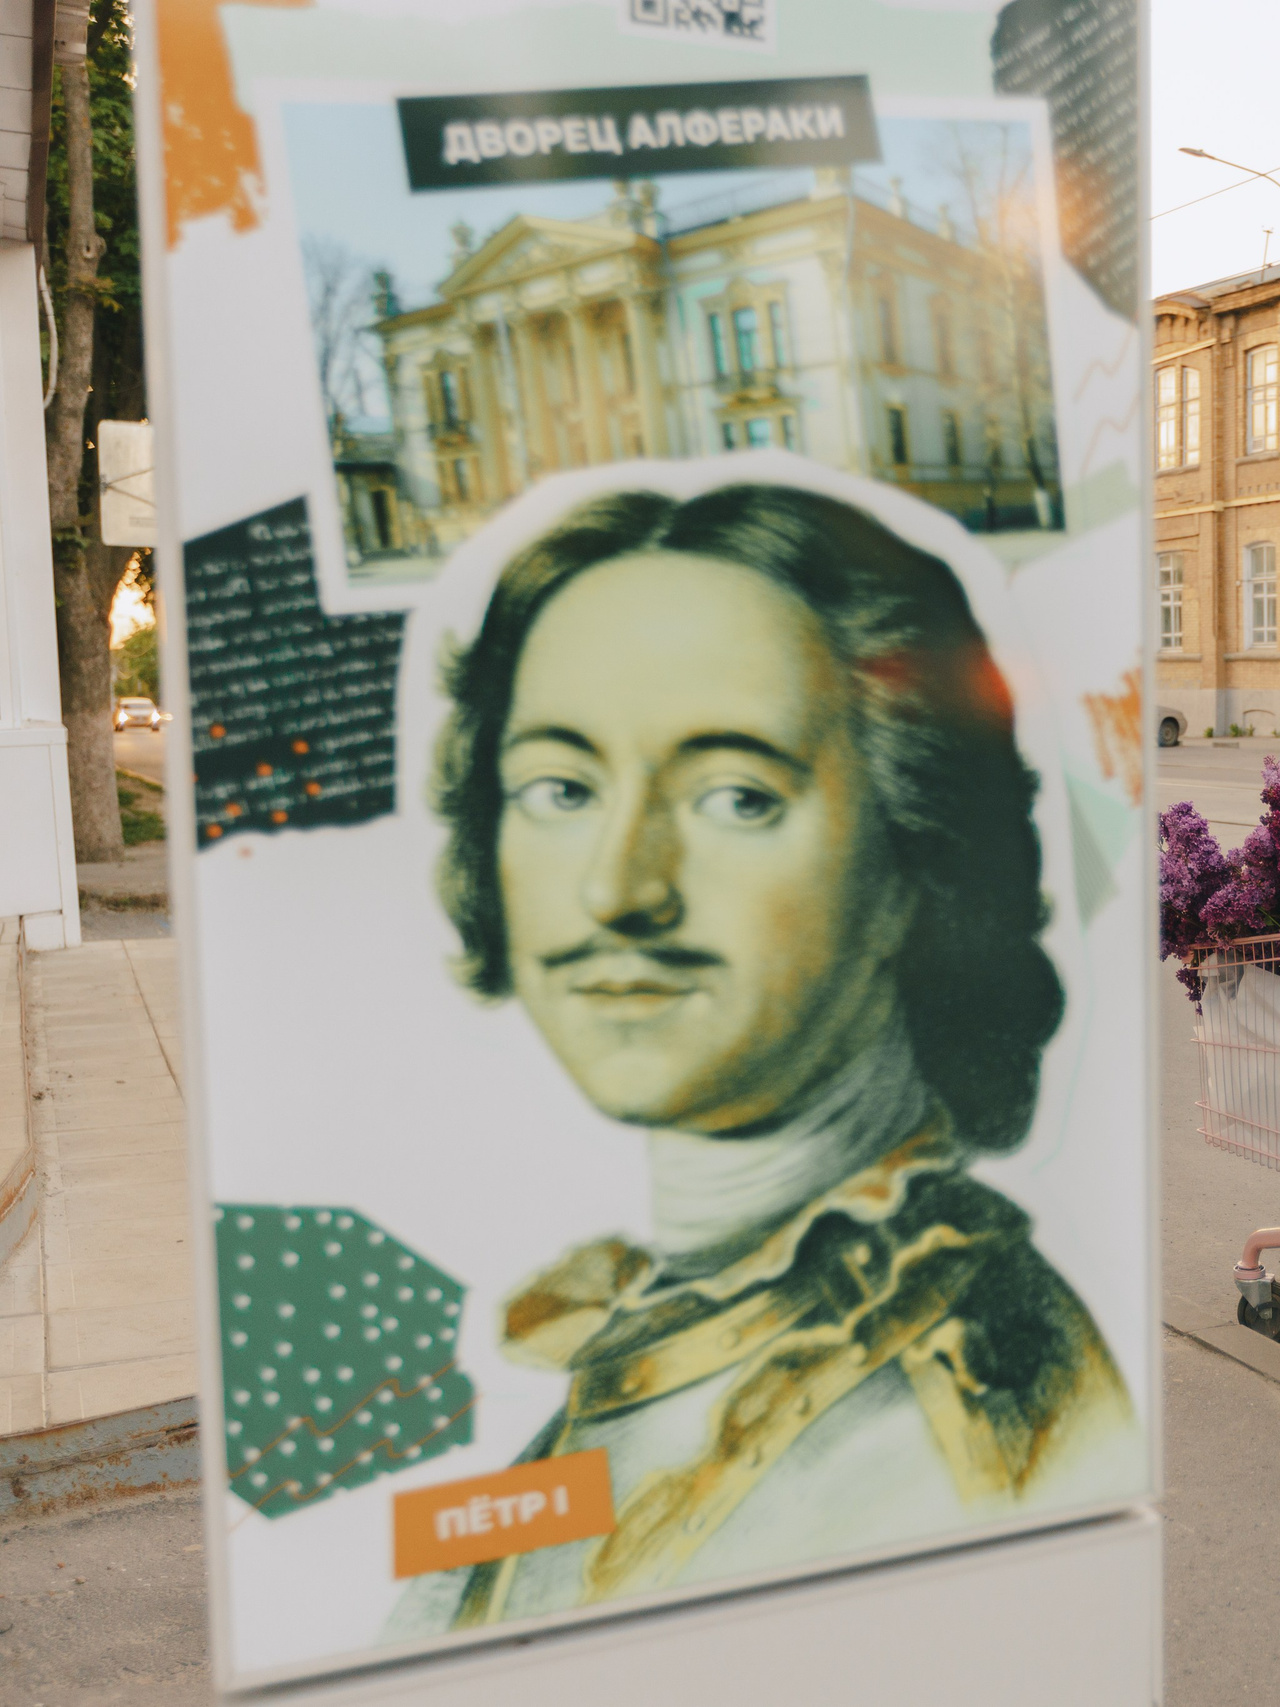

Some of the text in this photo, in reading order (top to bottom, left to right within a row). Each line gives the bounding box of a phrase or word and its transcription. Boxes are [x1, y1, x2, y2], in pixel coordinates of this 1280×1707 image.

[443, 105, 846, 165] ДВОРЕЦ АЛФЕРАКИ
[435, 1484, 569, 1541] ПЁТР I
